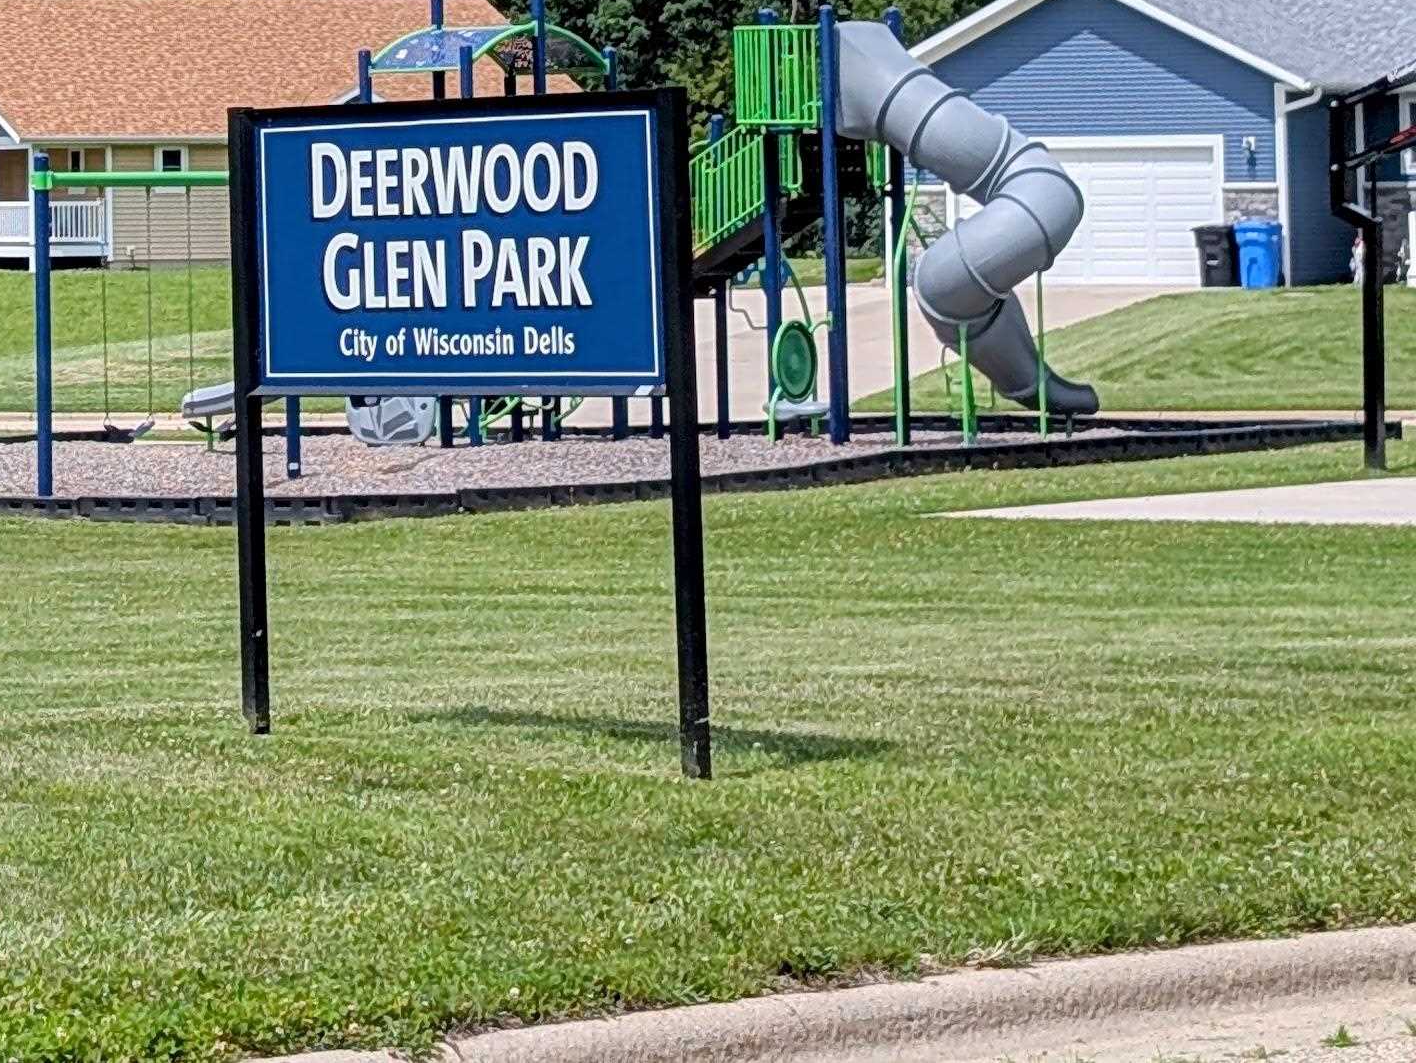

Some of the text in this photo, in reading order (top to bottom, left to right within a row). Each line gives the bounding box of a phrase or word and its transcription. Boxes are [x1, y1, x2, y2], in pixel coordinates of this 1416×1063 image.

[311, 141, 599, 219] DEERWOOD
[323, 229, 593, 310] GLEN PARK
[340, 325, 575, 361] City of Wisconsin Dells
